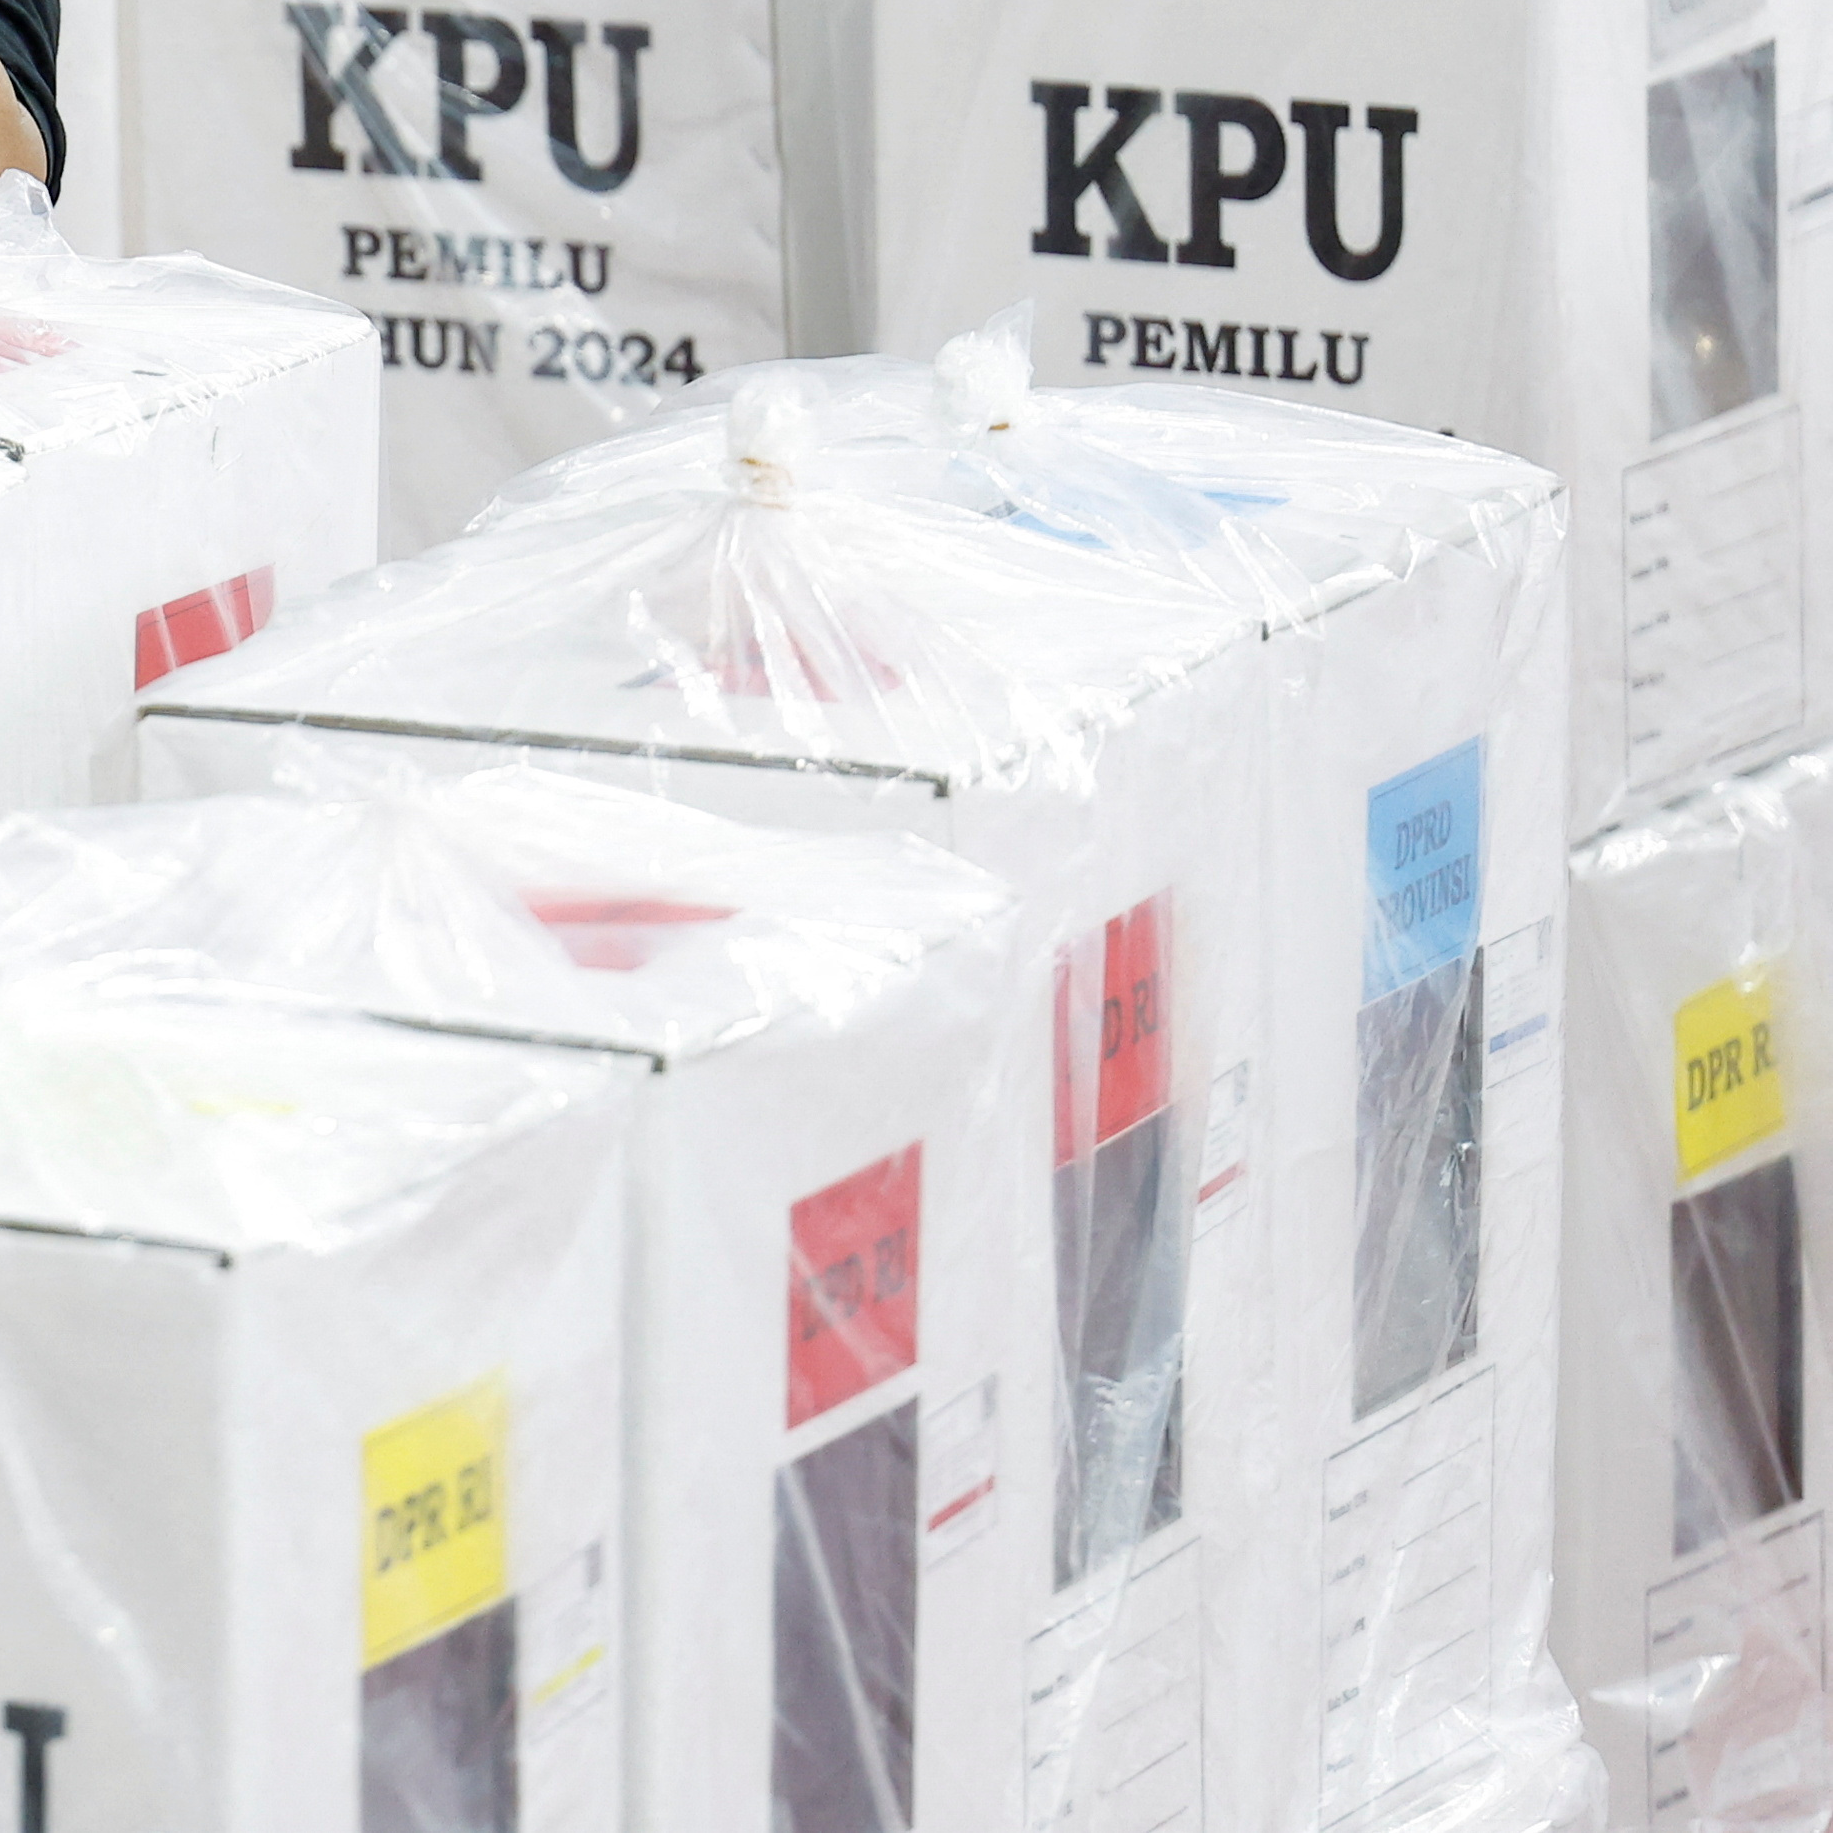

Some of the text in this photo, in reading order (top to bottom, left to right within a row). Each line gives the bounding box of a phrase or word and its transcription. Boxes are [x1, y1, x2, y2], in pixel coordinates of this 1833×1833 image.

[285, 0, 652, 195] KPU
[1030, 78, 1418, 282] KPU
[342, 225, 613, 293] PEMILU
[530, 325, 703, 386] 2024
[1084, 311, 1369, 386] PEMILU
[1396, 799, 1452, 870] DPRD
[1688, 1038, 1744, 1112] DPR
[376, 1456, 492, 1577] DPR RI
